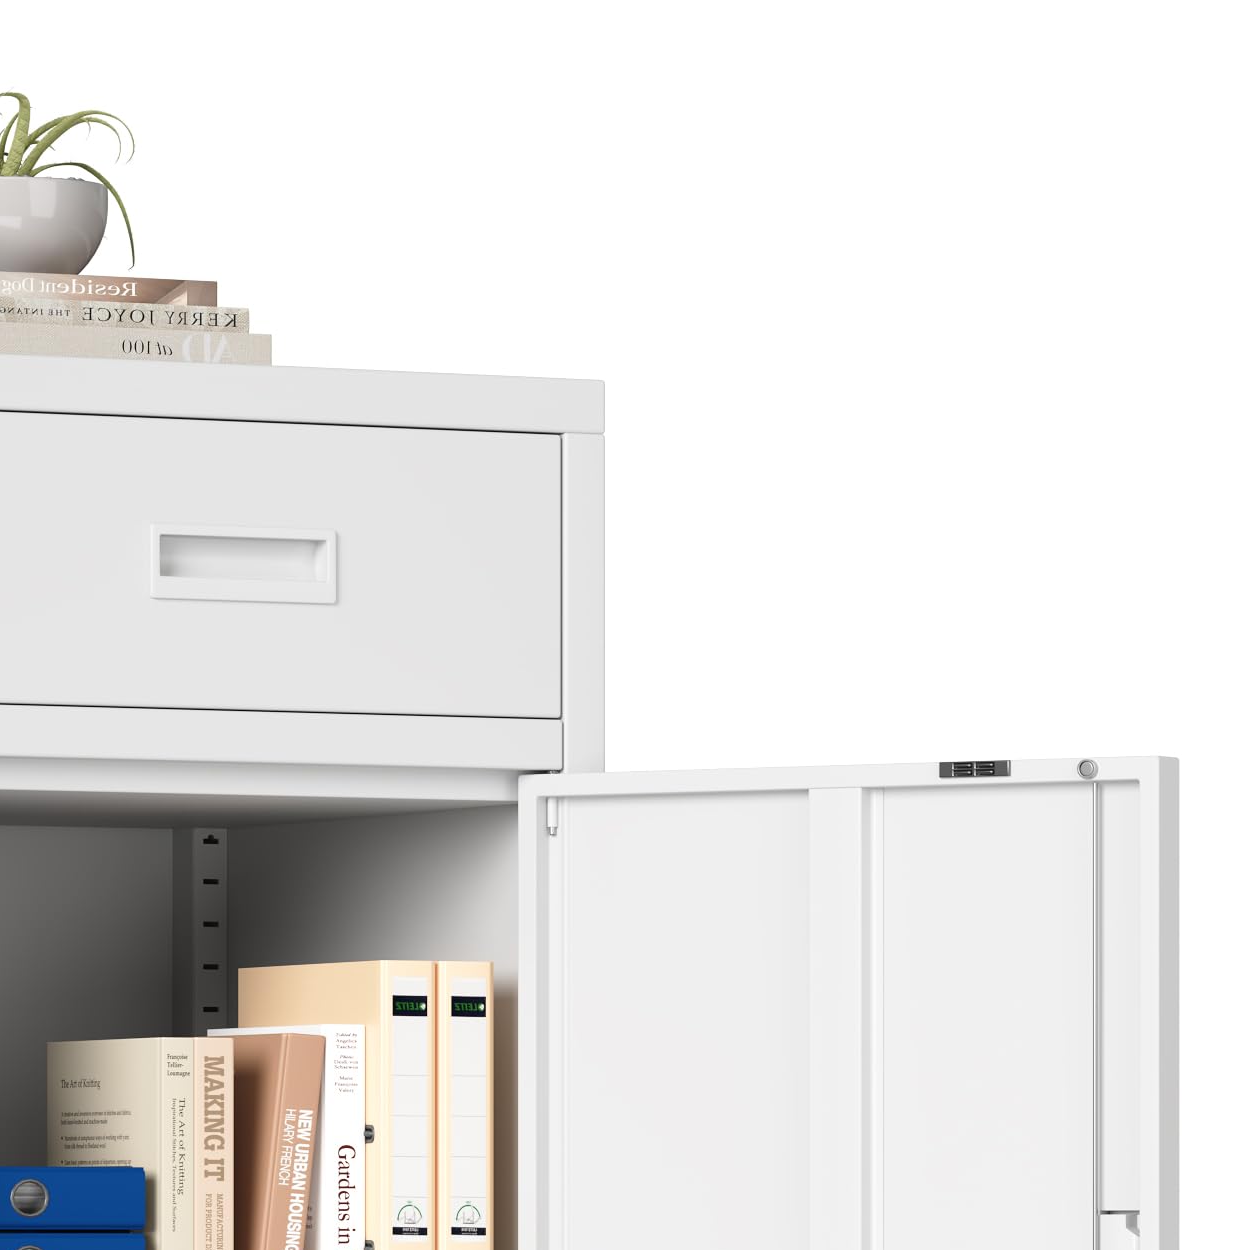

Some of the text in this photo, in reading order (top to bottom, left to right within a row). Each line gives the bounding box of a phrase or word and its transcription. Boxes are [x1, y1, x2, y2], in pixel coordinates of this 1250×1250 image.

[176, 1097, 186, 1195] The Art of Knitting
[203, 1056, 225, 1182] MAKING IT
[278, 1108, 297, 1187] HILARY FRENCH
[299, 1109, 313, 1142] NEW
[292, 1143, 310, 1191] URBAN
[336, 1144, 356, 1221] Gardens
[337, 1229, 356, 1246] in
